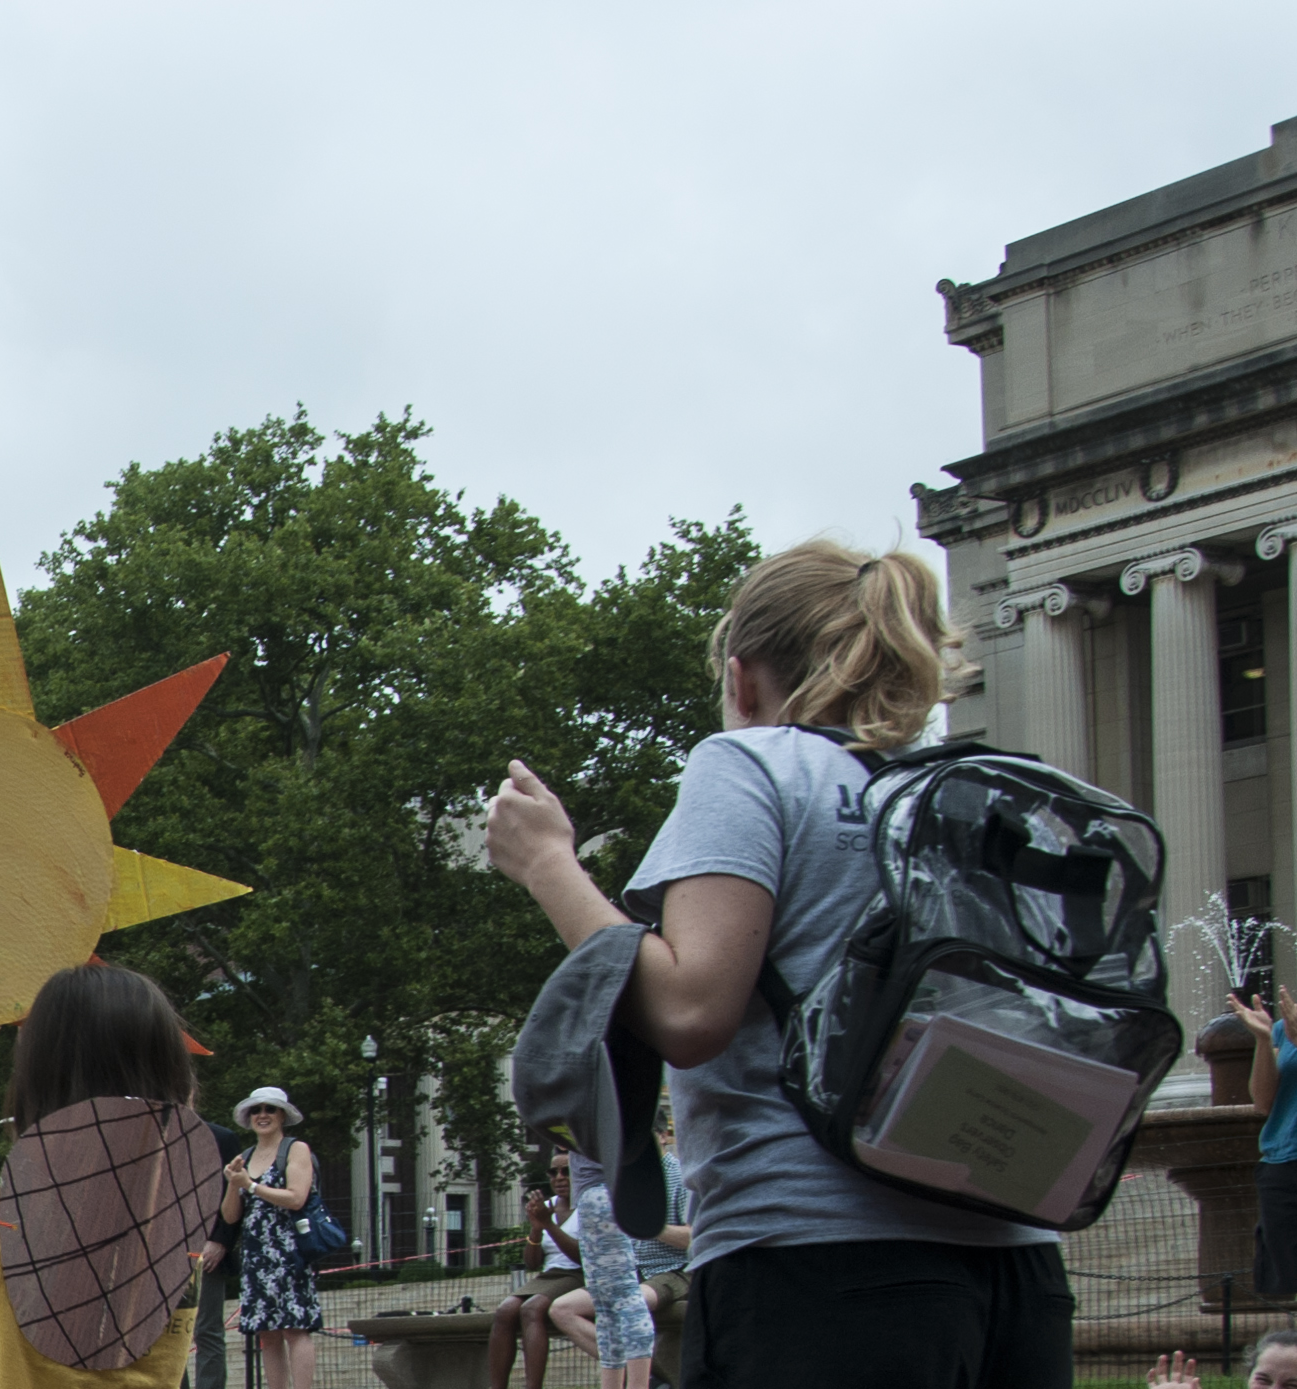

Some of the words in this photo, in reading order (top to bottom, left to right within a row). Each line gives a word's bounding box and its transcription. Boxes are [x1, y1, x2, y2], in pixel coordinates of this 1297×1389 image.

[1163, 317, 1212, 345] WHEN
[1220, 300, 1264, 327] THEY
[1054, 479, 1135, 519] MDCCLIV
[959, 1121, 1016, 1159] Observers
[979, 1112, 1017, 1141] Dance
